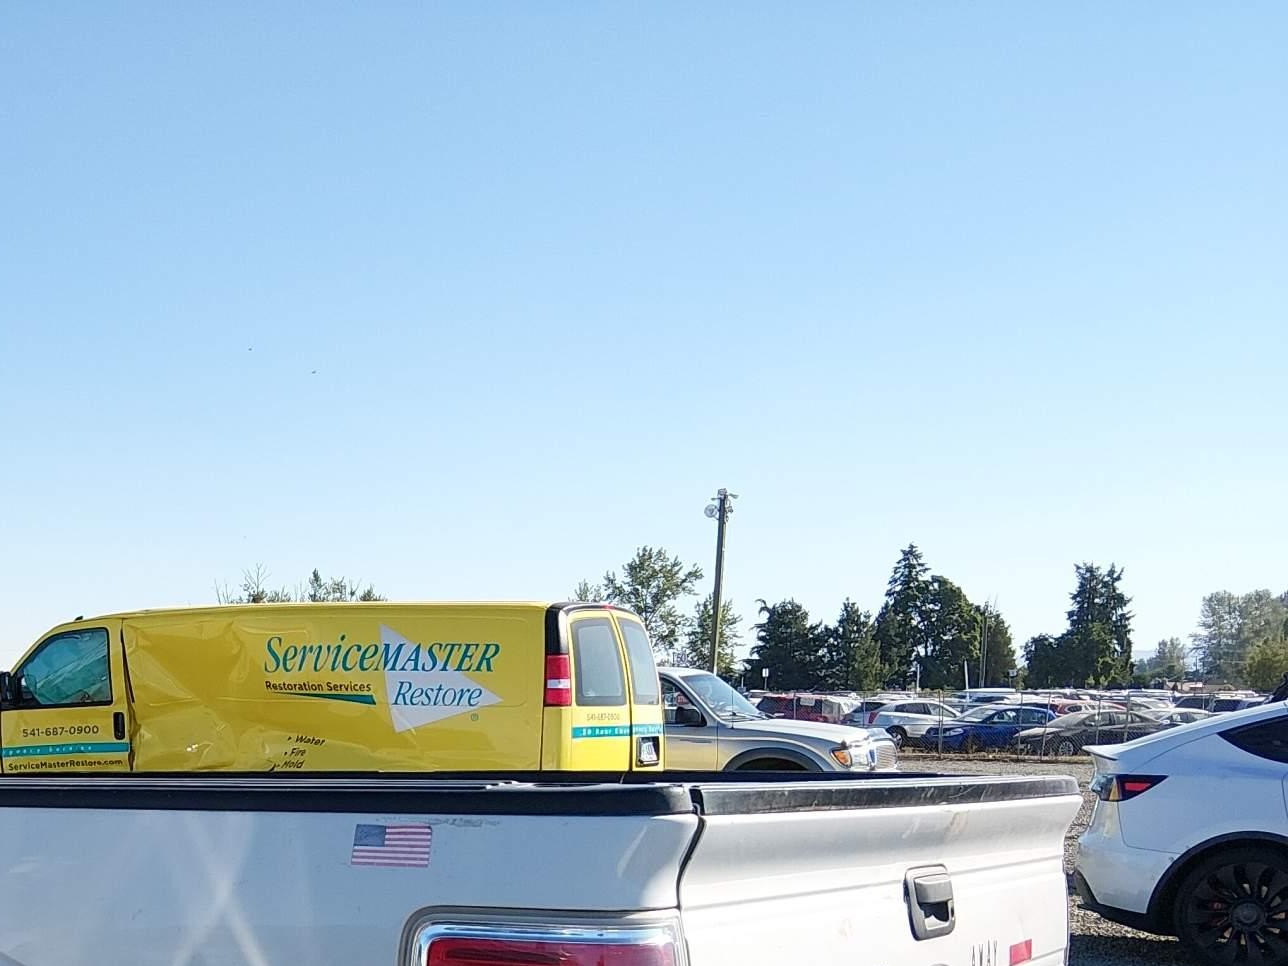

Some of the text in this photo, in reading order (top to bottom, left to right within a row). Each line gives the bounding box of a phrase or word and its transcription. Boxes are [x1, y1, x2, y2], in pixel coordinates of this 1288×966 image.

[264, 634, 501, 673] ServiceMASTER
[265, 680, 372, 692] Restoration Services
[391, 681, 483, 707] Restore
[22, 725, 100, 738] 541-687-0900
[295, 735, 326, 746] Water
[290, 747, 306, 757] Fire
[8, 759, 123, 771] ServiceMasterRestore.com
[281, 760, 305, 769] Mold
